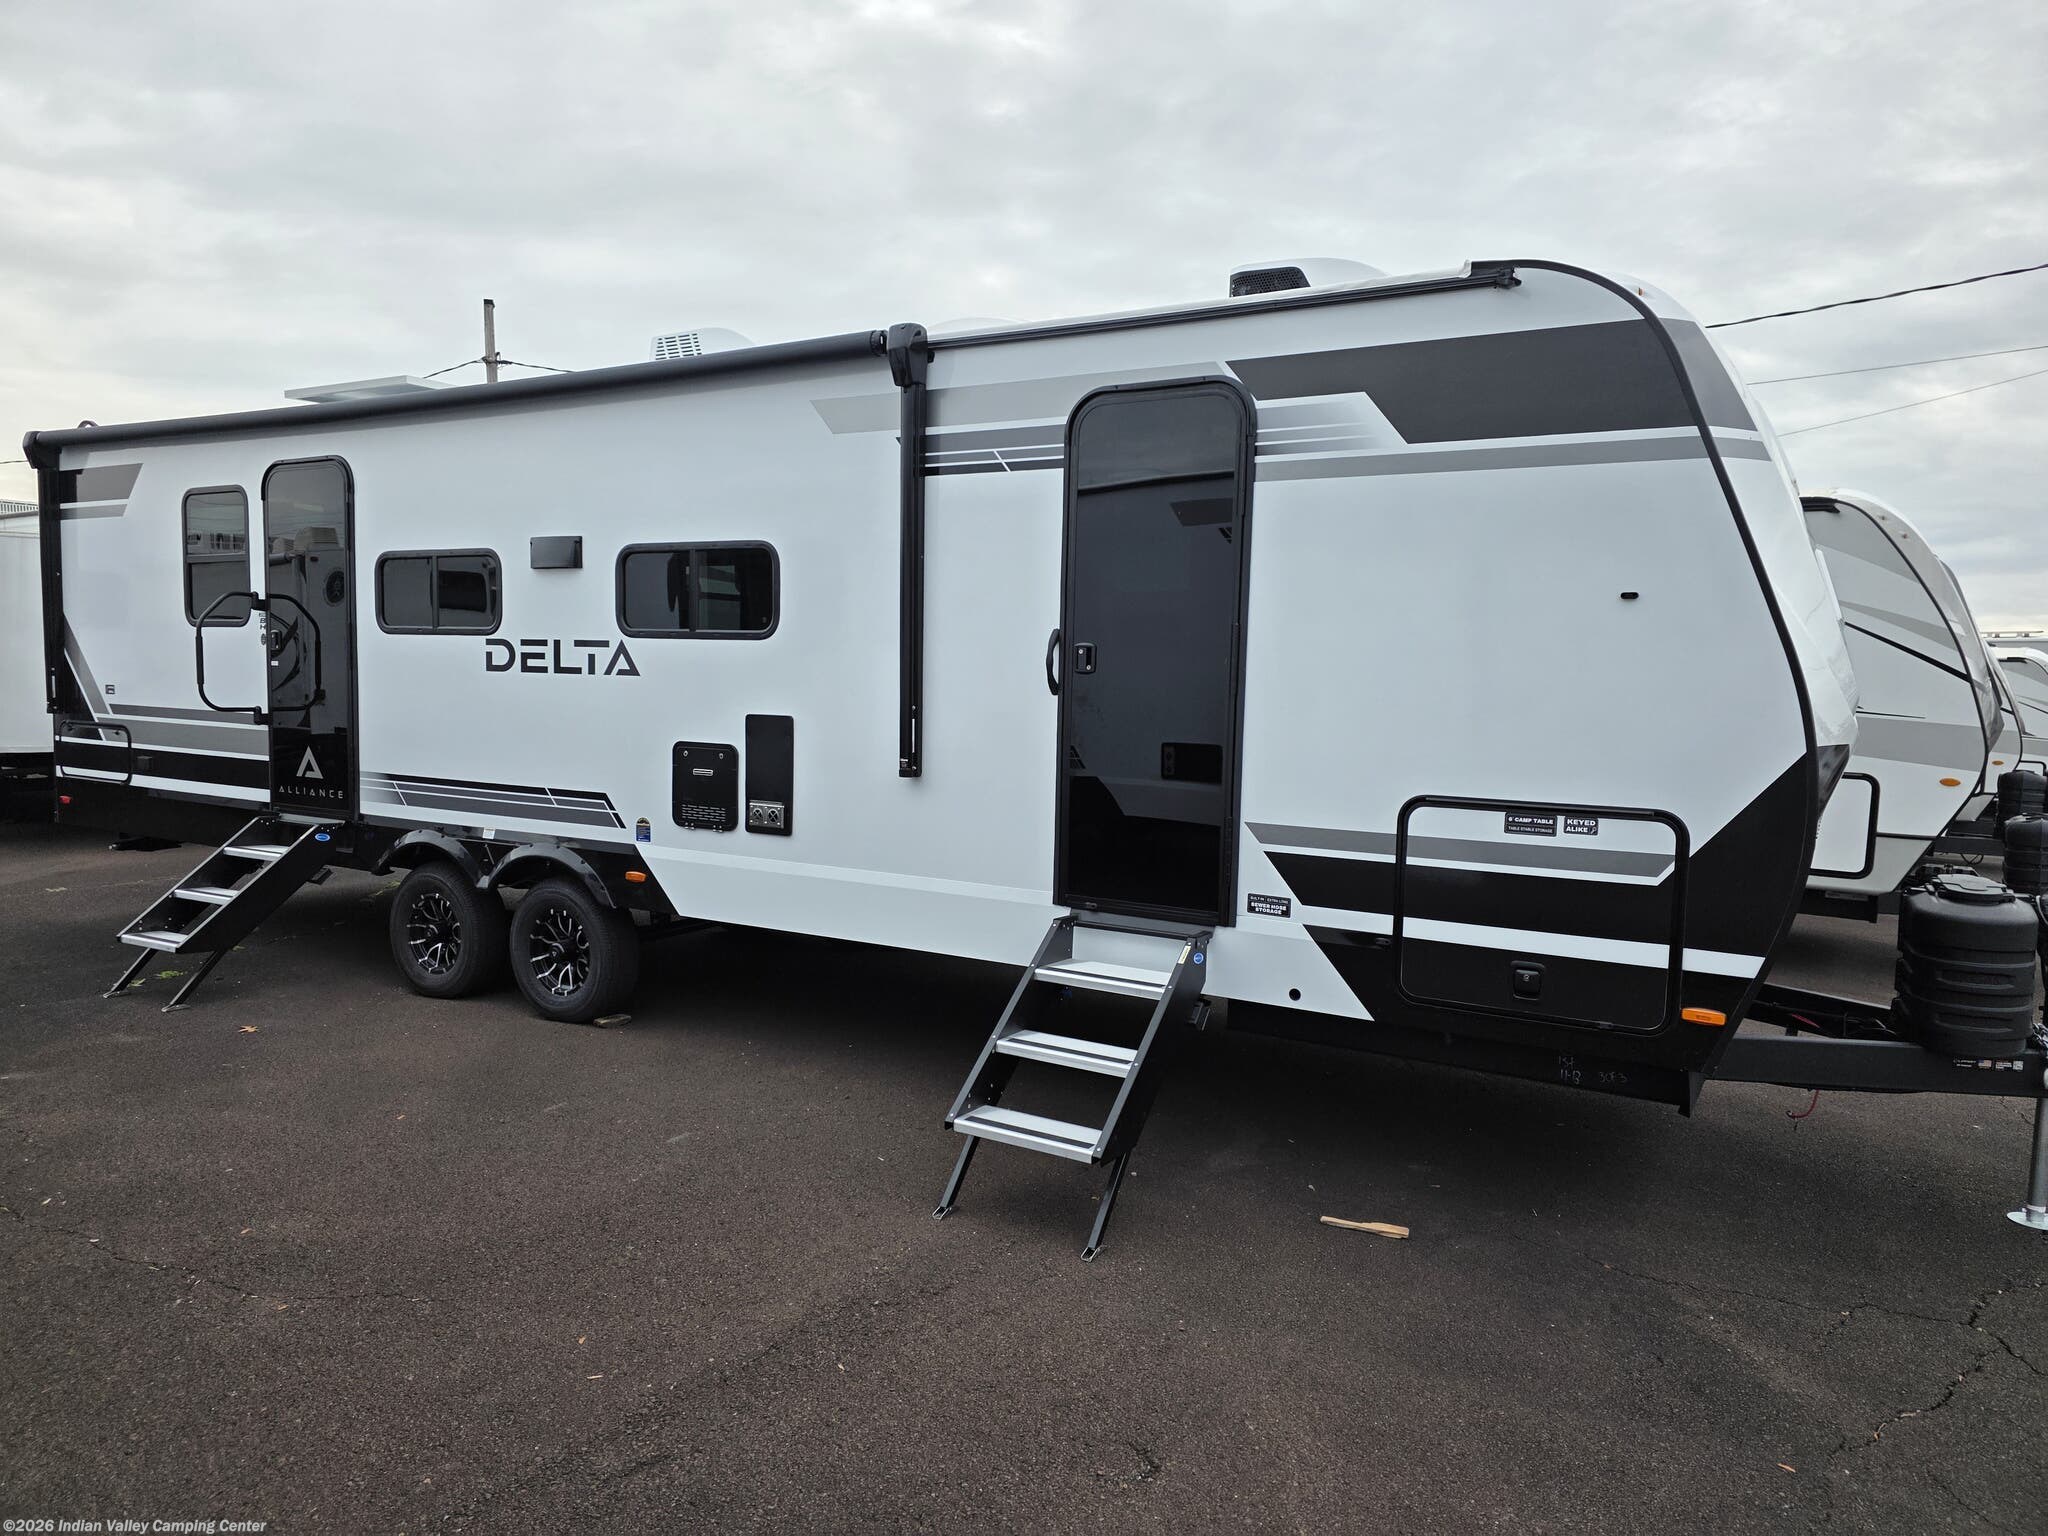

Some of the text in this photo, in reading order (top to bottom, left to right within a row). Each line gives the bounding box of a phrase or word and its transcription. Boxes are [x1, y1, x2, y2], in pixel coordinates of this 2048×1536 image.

[486, 638, 641, 676] DELTA
[279, 785, 344, 799] ALLIANCE
[1567, 818, 1596, 826] KEYED
[1566, 825, 1588, 833] ALIKE
